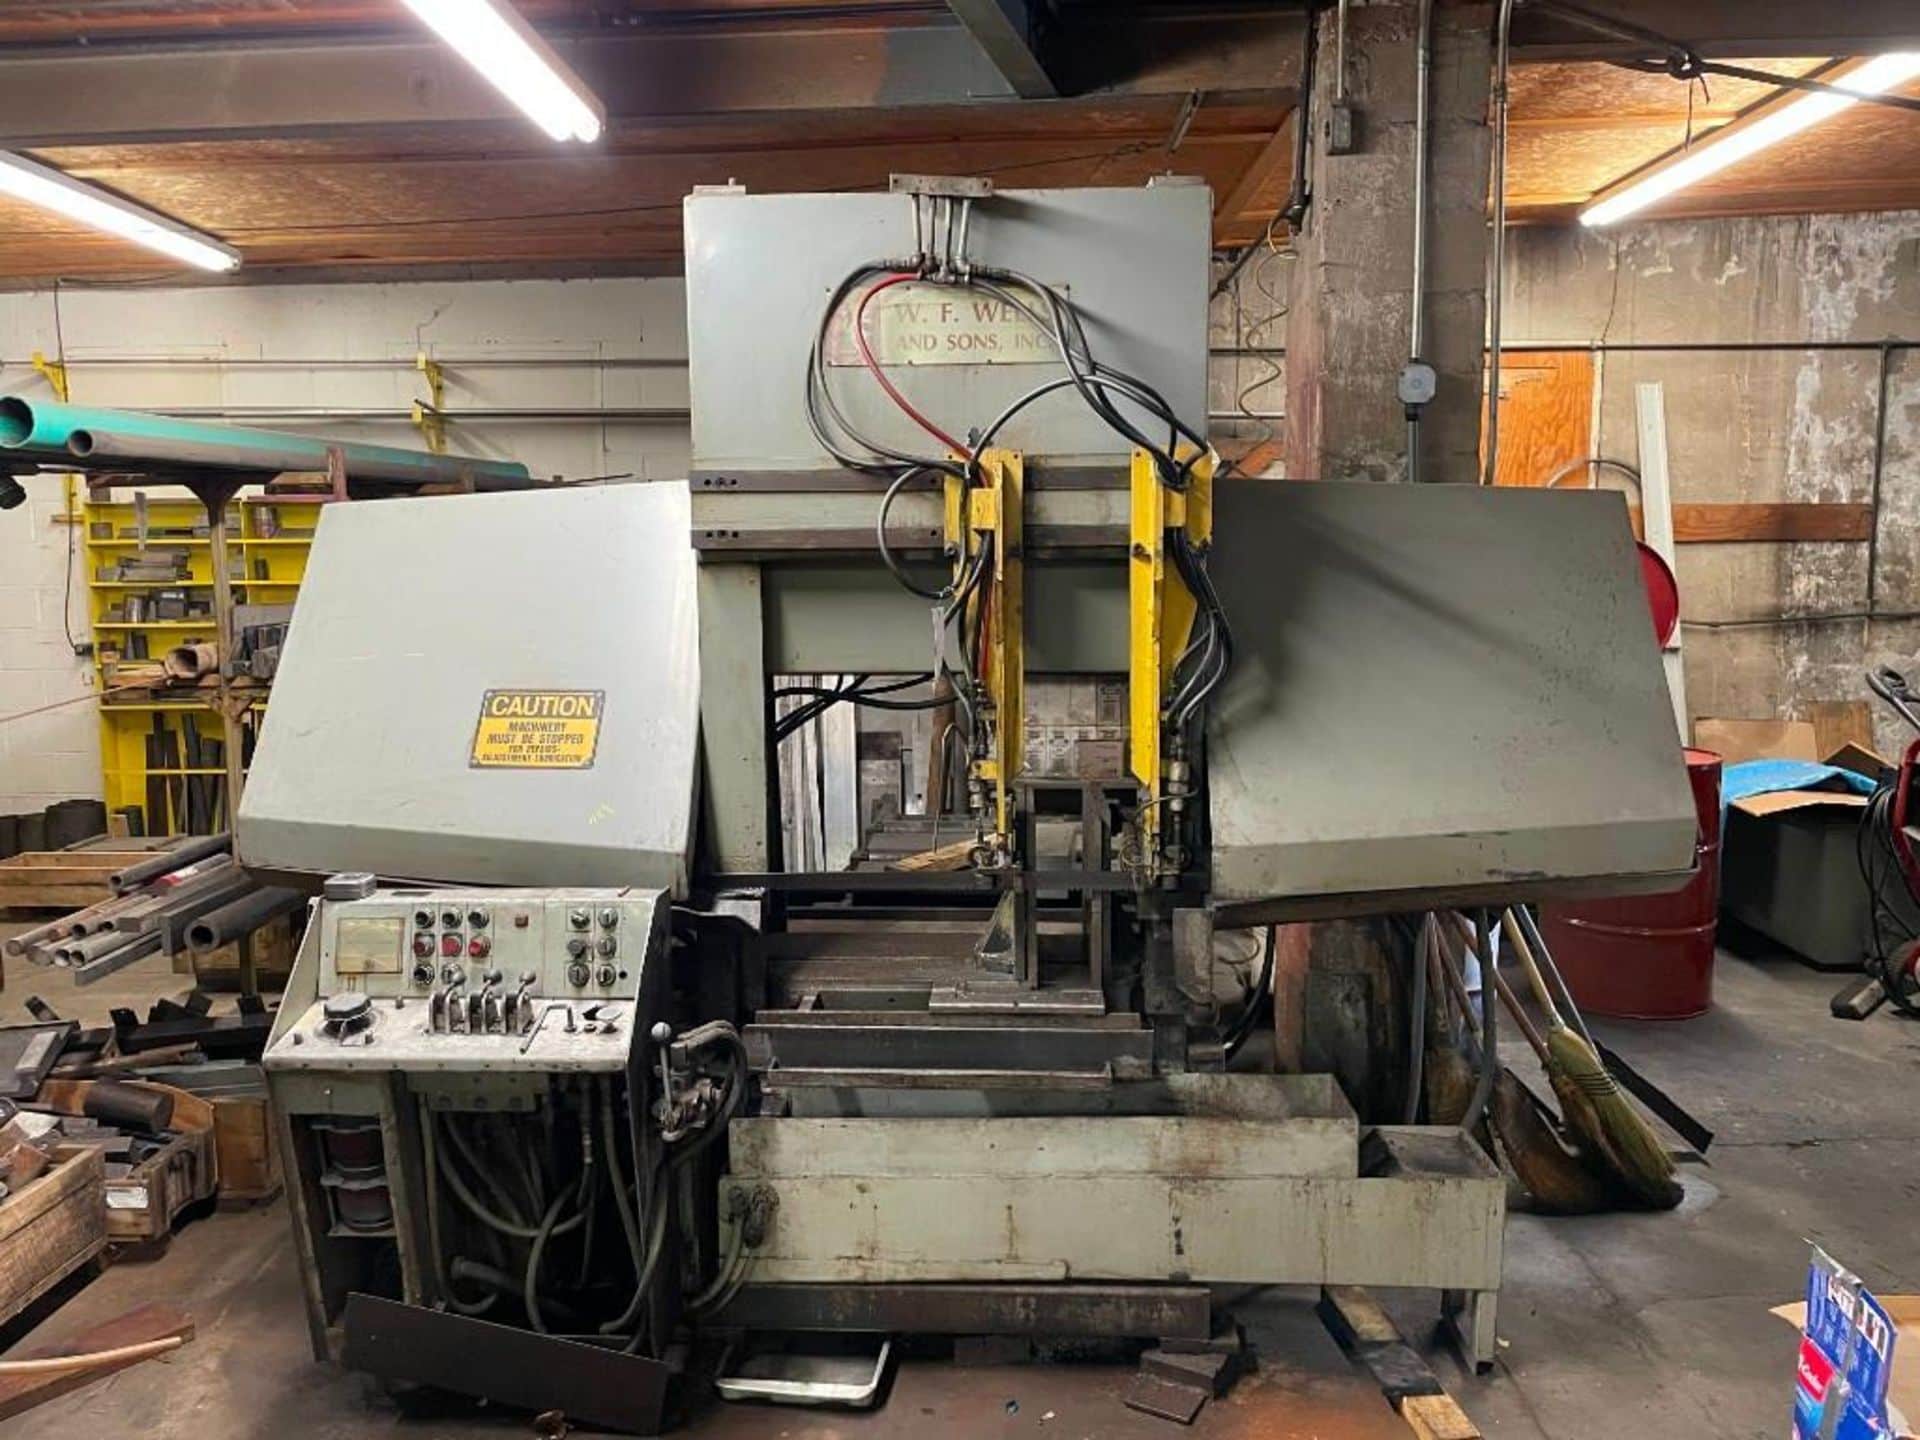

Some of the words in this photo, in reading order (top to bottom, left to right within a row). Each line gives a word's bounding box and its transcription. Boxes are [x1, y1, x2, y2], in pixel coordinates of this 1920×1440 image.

[896, 302, 927, 323] W.
[941, 302, 959, 323] F.
[896, 333, 937, 351] AND
[492, 696, 595, 716] CAUTION
[509, 722, 567, 732] MACHINERY
[487, 734, 516, 744] MUST
[521, 734, 535, 744] BE
[539, 733, 584, 744] STOPPED
